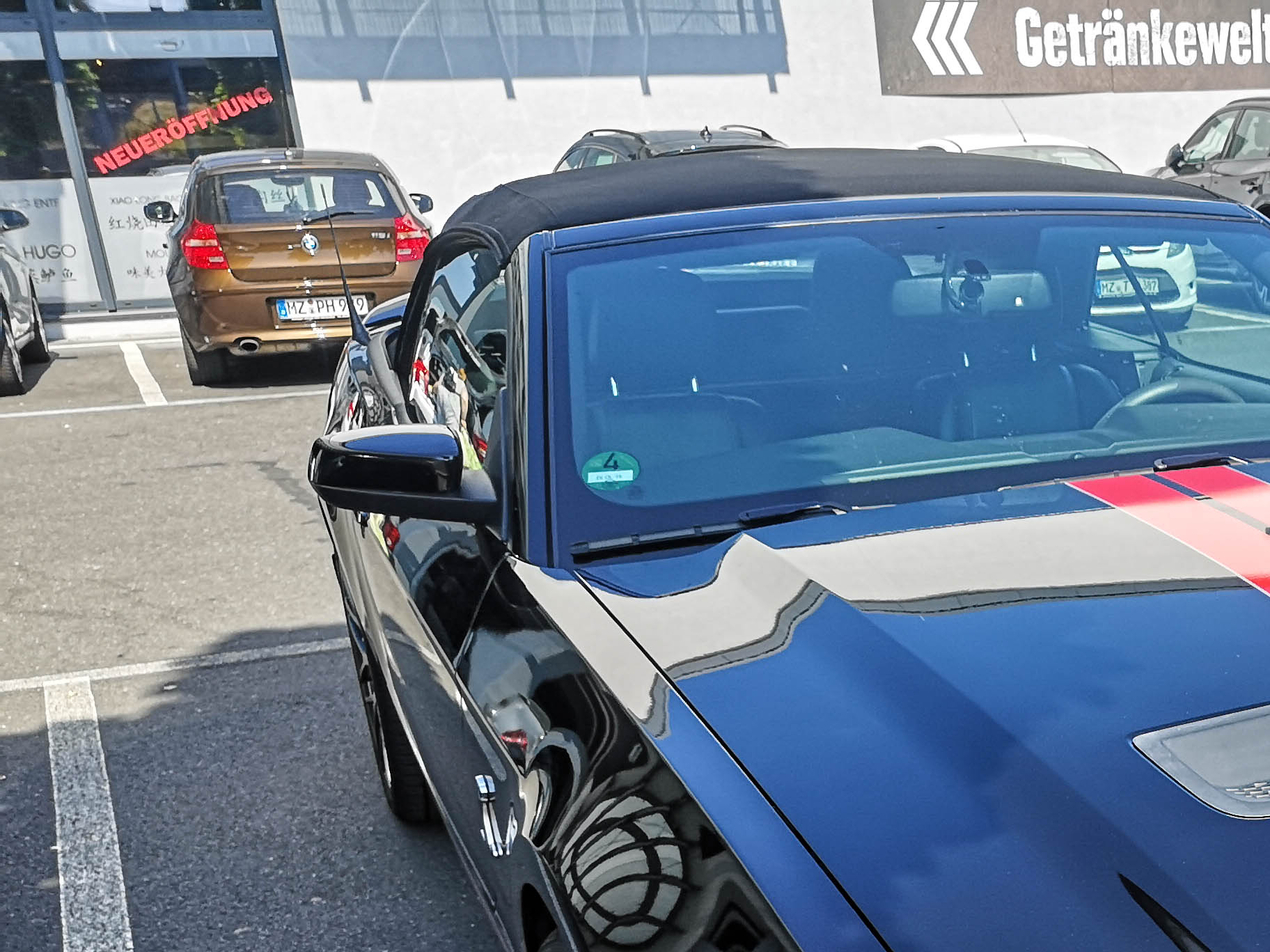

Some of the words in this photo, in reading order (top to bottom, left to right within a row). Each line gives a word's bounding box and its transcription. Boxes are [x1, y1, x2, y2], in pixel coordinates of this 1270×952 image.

[93, 87, 273, 175] NEUERÖFFNUNG
[23, 244, 76, 259] HUGO
[1101, 282, 1115, 293] MZ
[287, 300, 307, 314] MZ
[316, 300, 336, 313] PH
[339, 298, 365, 312] 99
[604, 453, 619, 470] 4
